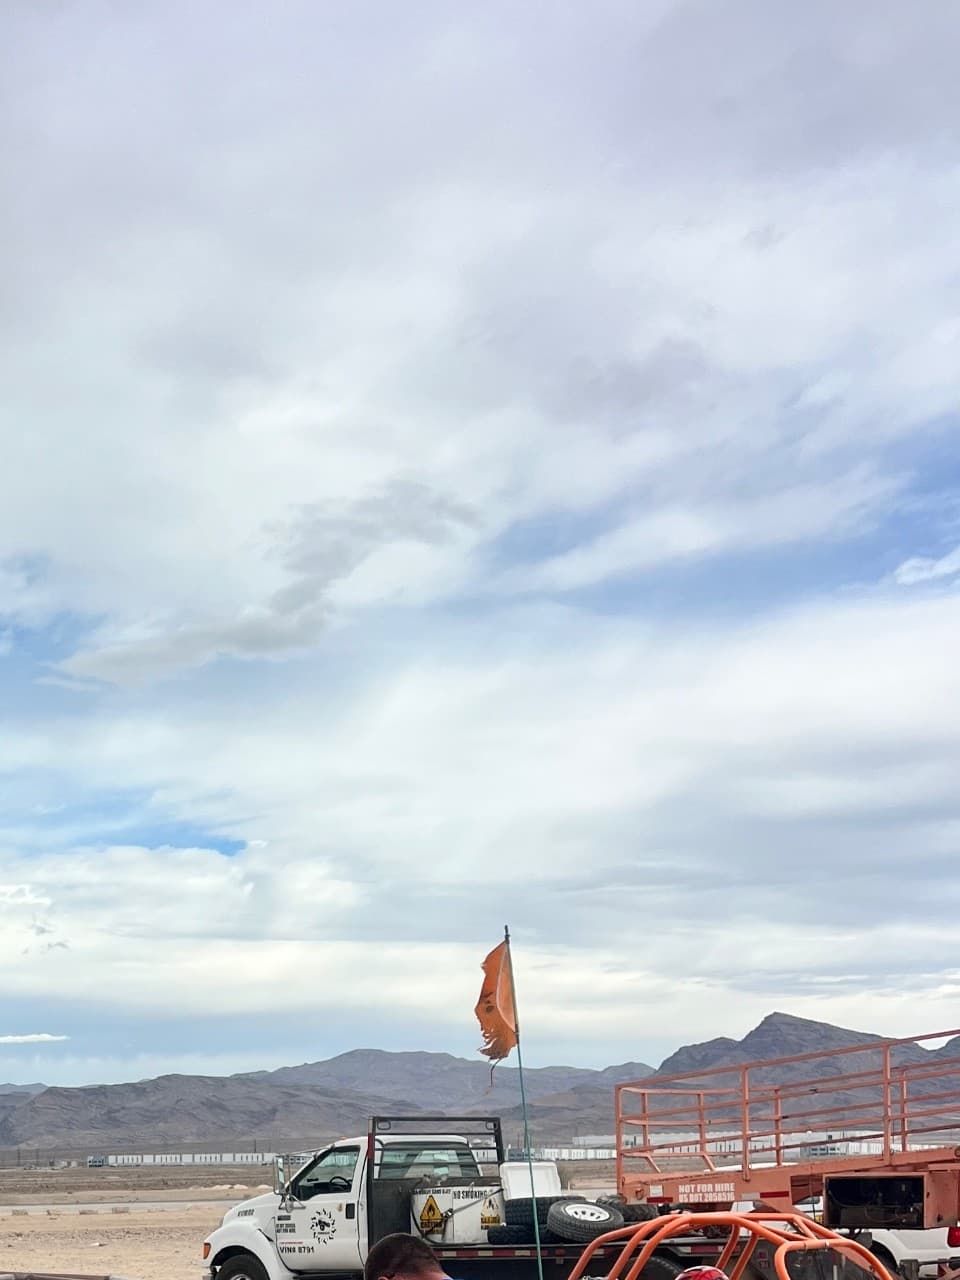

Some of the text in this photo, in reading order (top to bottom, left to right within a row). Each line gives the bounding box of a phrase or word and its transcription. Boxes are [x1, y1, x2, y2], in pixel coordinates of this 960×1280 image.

[678, 1182, 735, 1193] NOT FOR HIRE
[452, 1190, 460, 1200] NO
